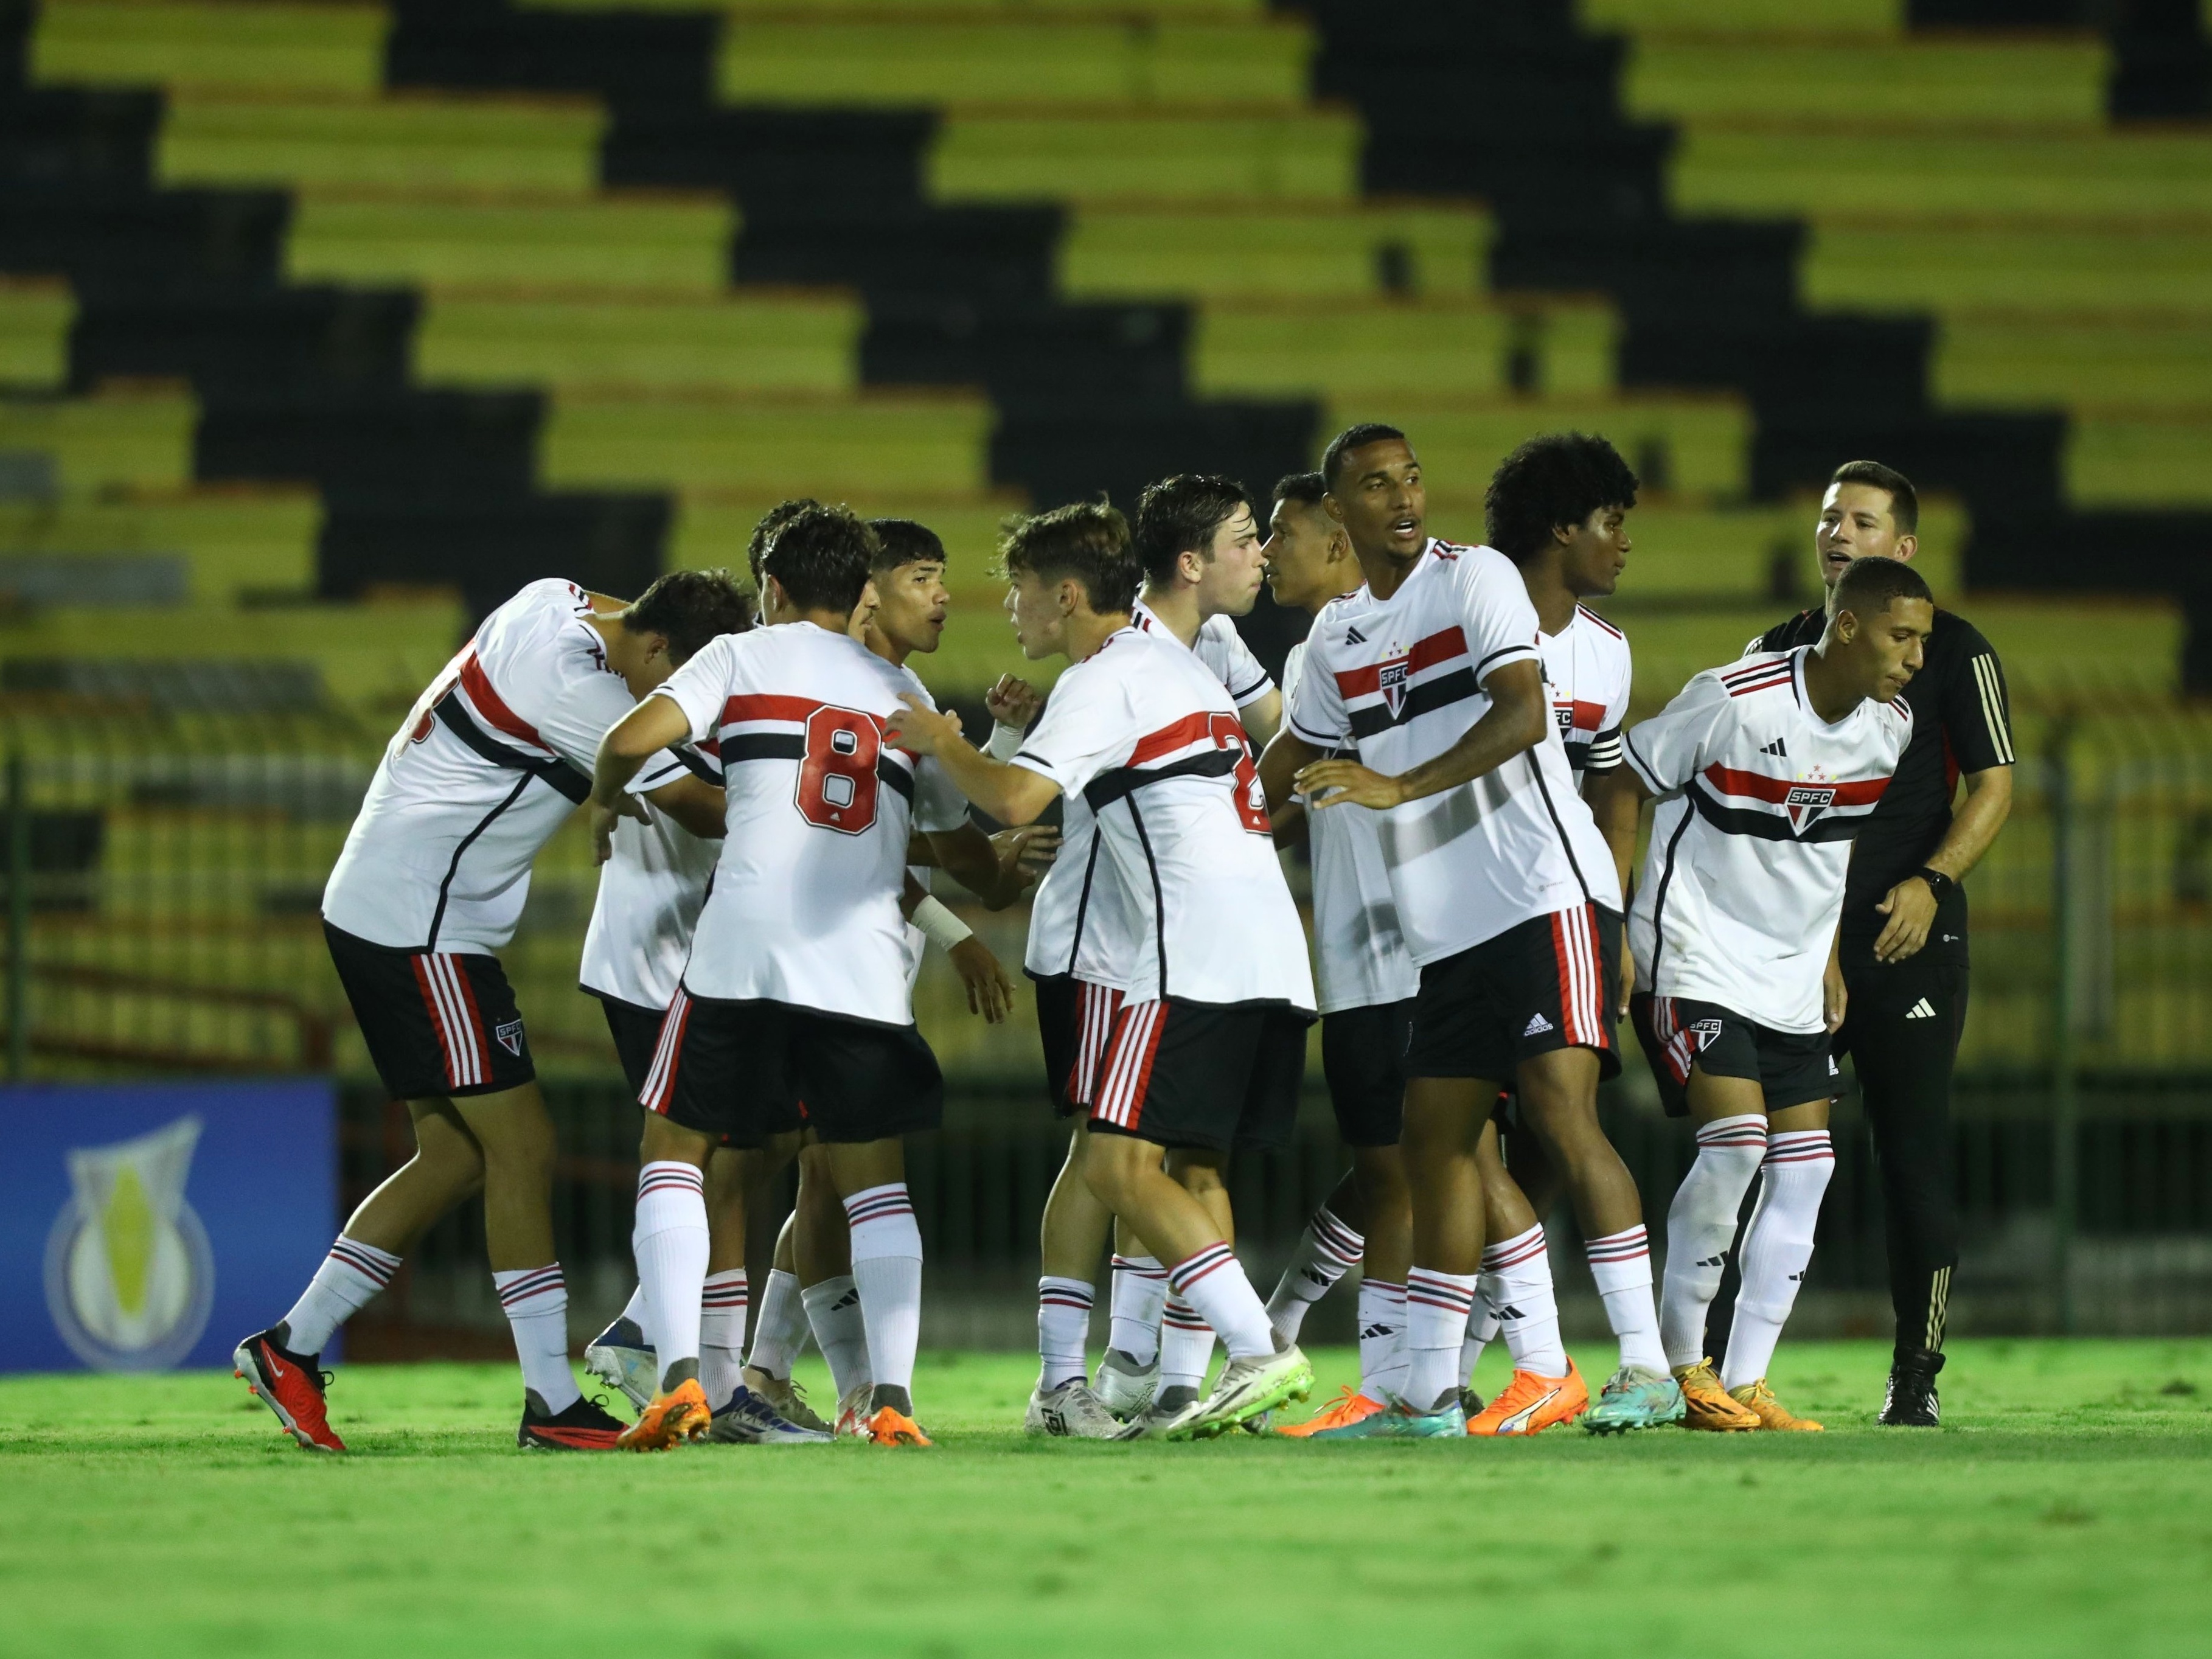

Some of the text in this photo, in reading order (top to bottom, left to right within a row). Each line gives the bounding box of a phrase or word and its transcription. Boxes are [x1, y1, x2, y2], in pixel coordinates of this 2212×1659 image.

[1381, 666, 1408, 684] SPFC
[793, 703, 882, 836] 8
[1790, 791, 1831, 803] SPFC
[499, 1023, 521, 1036] SPFC
[1524, 1023, 1554, 1037] adidas
